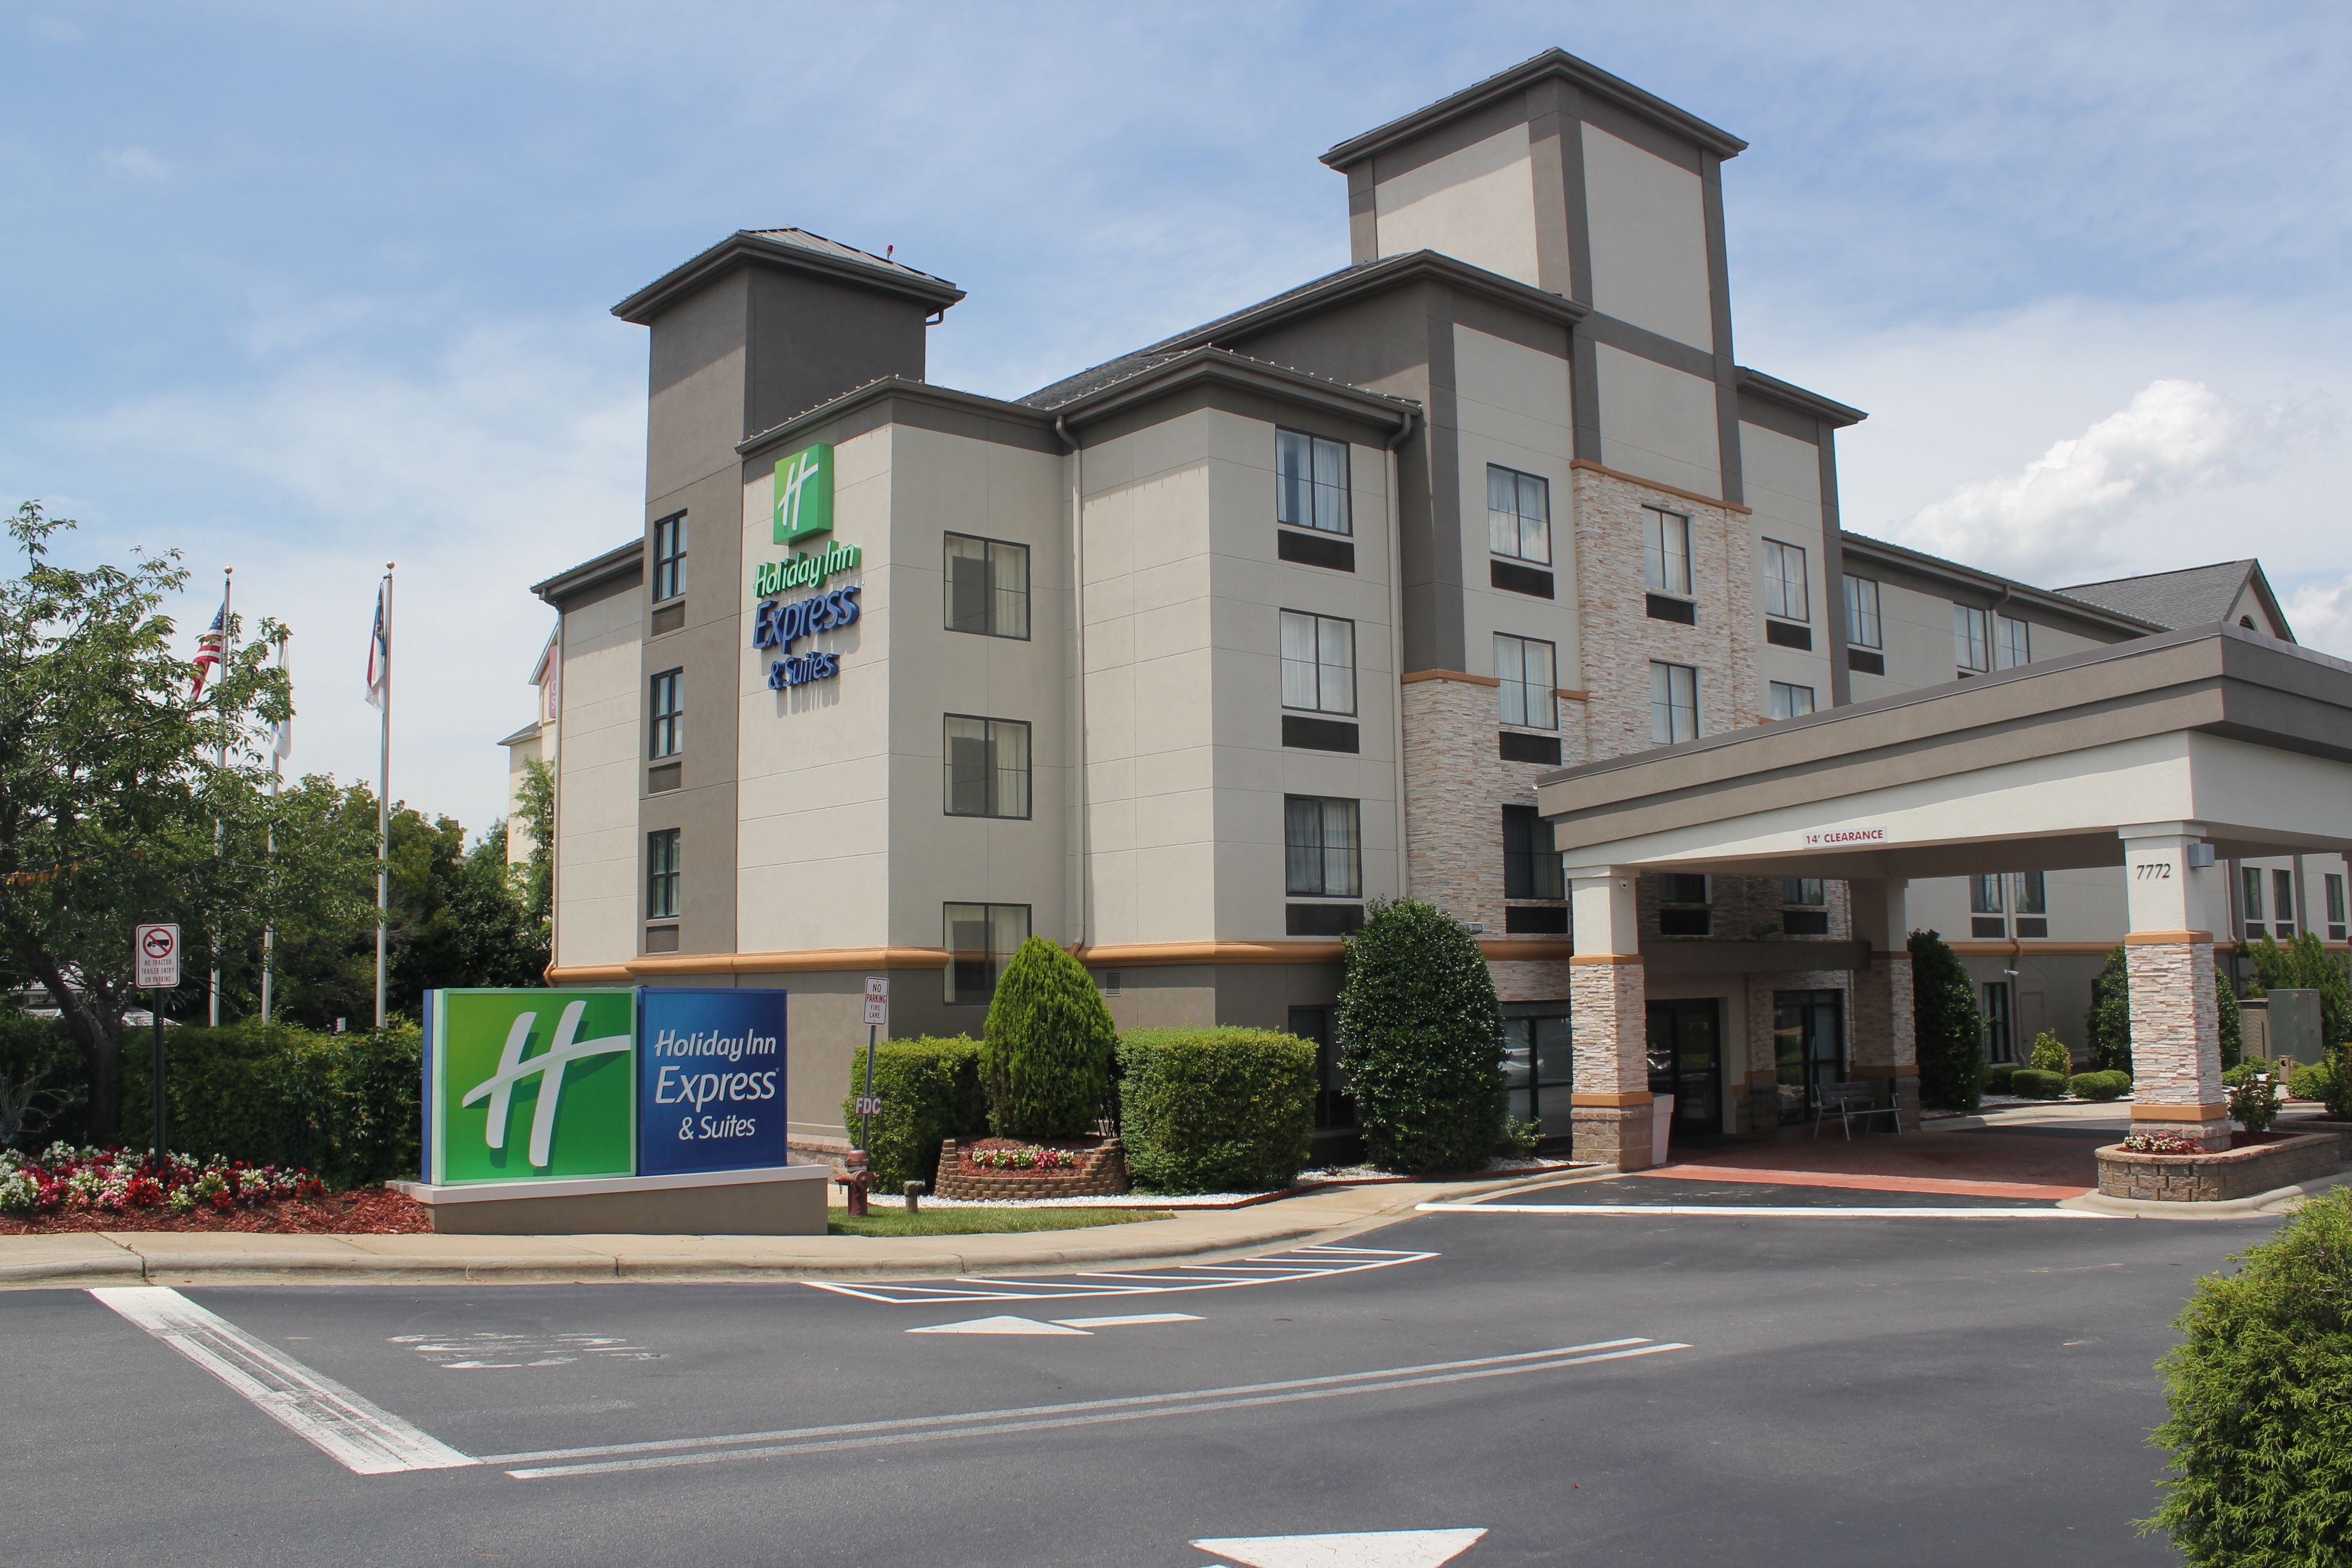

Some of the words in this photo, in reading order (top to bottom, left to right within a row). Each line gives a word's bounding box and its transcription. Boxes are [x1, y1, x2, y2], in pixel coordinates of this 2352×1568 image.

[753, 552, 825, 598] Holiday
[824, 540, 861, 575] Inn
[753, 586, 861, 655] Express
[768, 660, 786, 690] &
[783, 651, 840, 687] Suites
[1823, 830, 1883, 843] CLEARANCE
[2136, 862, 2171, 880] 7772
[866, 993, 886, 1004] PARKING
[872, 983, 881, 993] NO
[654, 1029, 744, 1062] Holiday
[745, 1028, 777, 1055] Inn
[655, 1065, 777, 1113] Express
[855, 1097, 882, 1115] FDC
[678, 1116, 695, 1140] &
[698, 1115, 756, 1139] Suites
